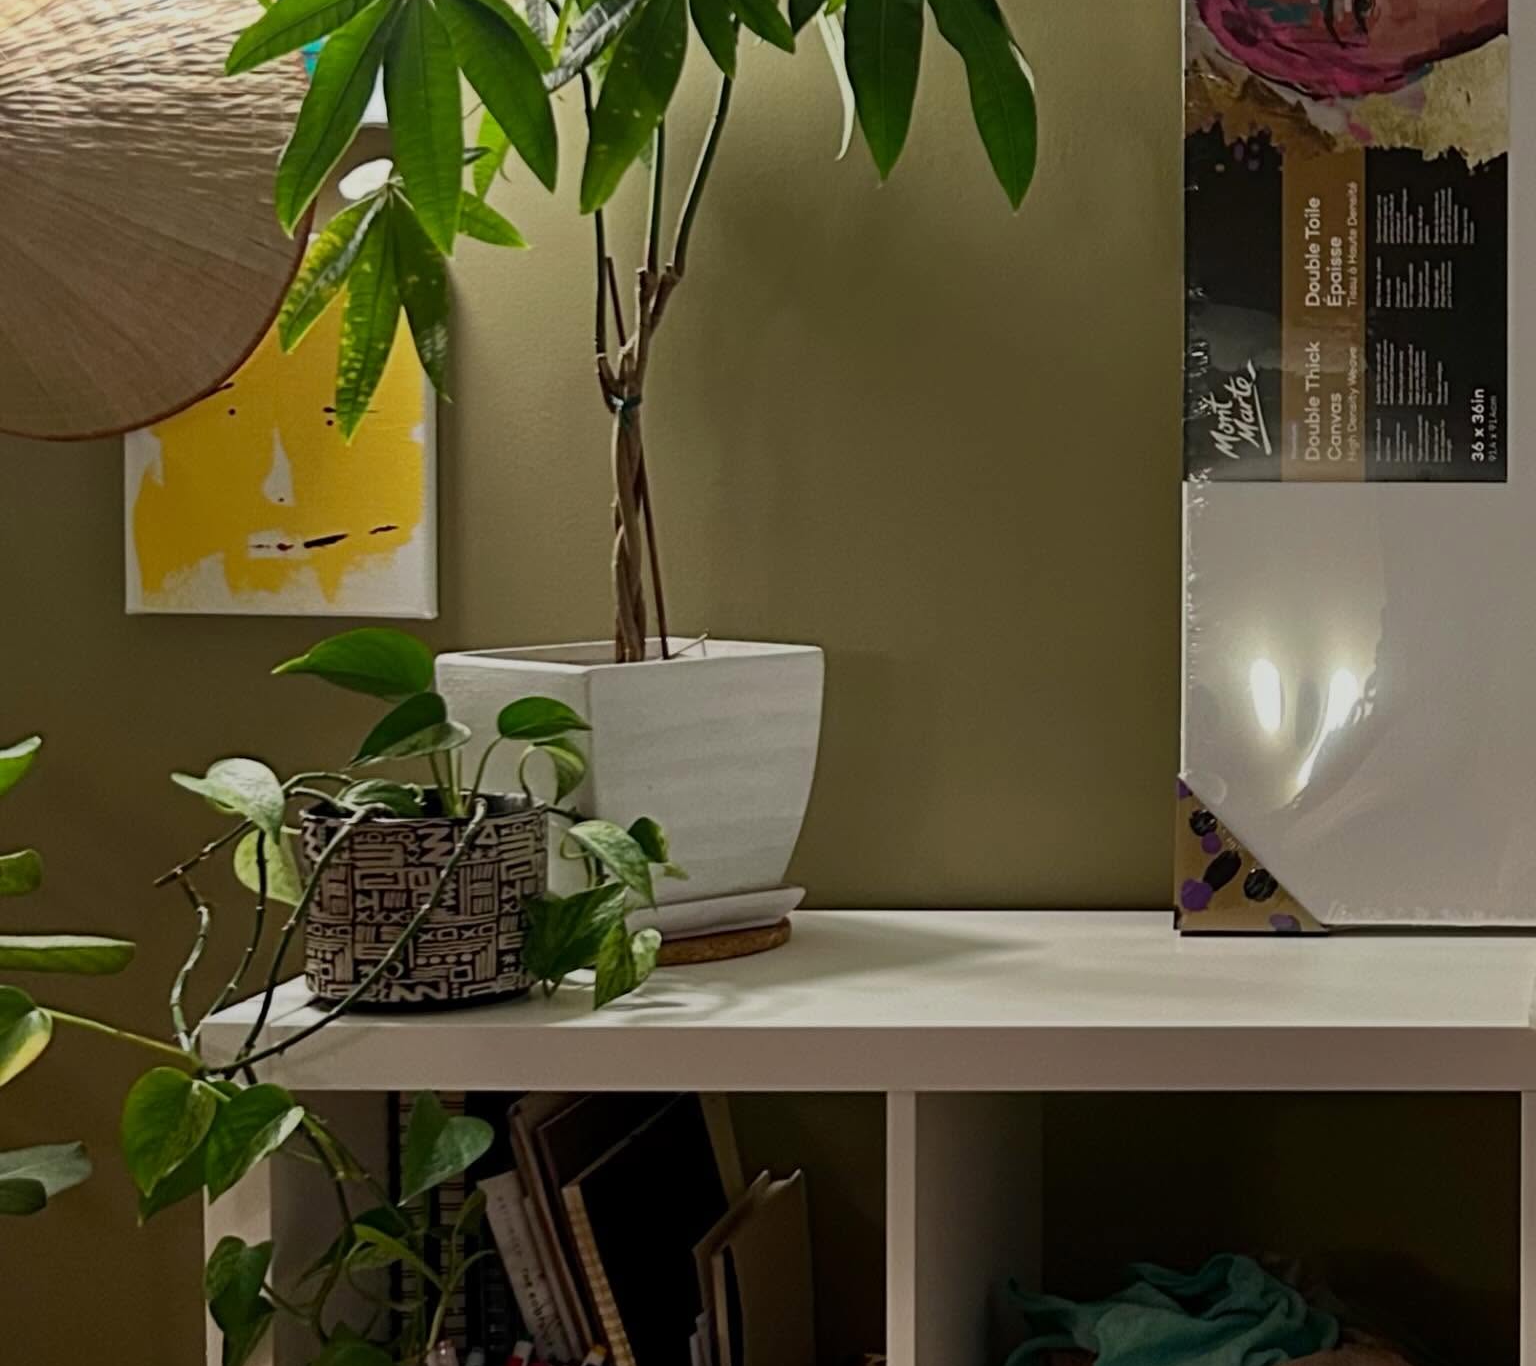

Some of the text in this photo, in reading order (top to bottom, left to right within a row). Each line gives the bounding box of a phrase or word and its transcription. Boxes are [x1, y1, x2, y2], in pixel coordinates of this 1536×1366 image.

[1347, 182, 1358, 226] Densité
[1305, 197, 1320, 306] Double Toile
[1322, 236, 1346, 307] Épaisse
[1348, 229, 1357, 264] Haute
[1347, 277, 1357, 307] Tissu
[1348, 347, 1357, 386] Weave
[1203, 392, 1240, 458] Mont
[1225, 366, 1260, 448] Marte
[1305, 342, 1320, 460] Double Thick
[1328, 393, 1342, 460] Canvas
[1348, 389, 1360, 431] Density
[1471, 388, 1485, 461] 36 x 36in
